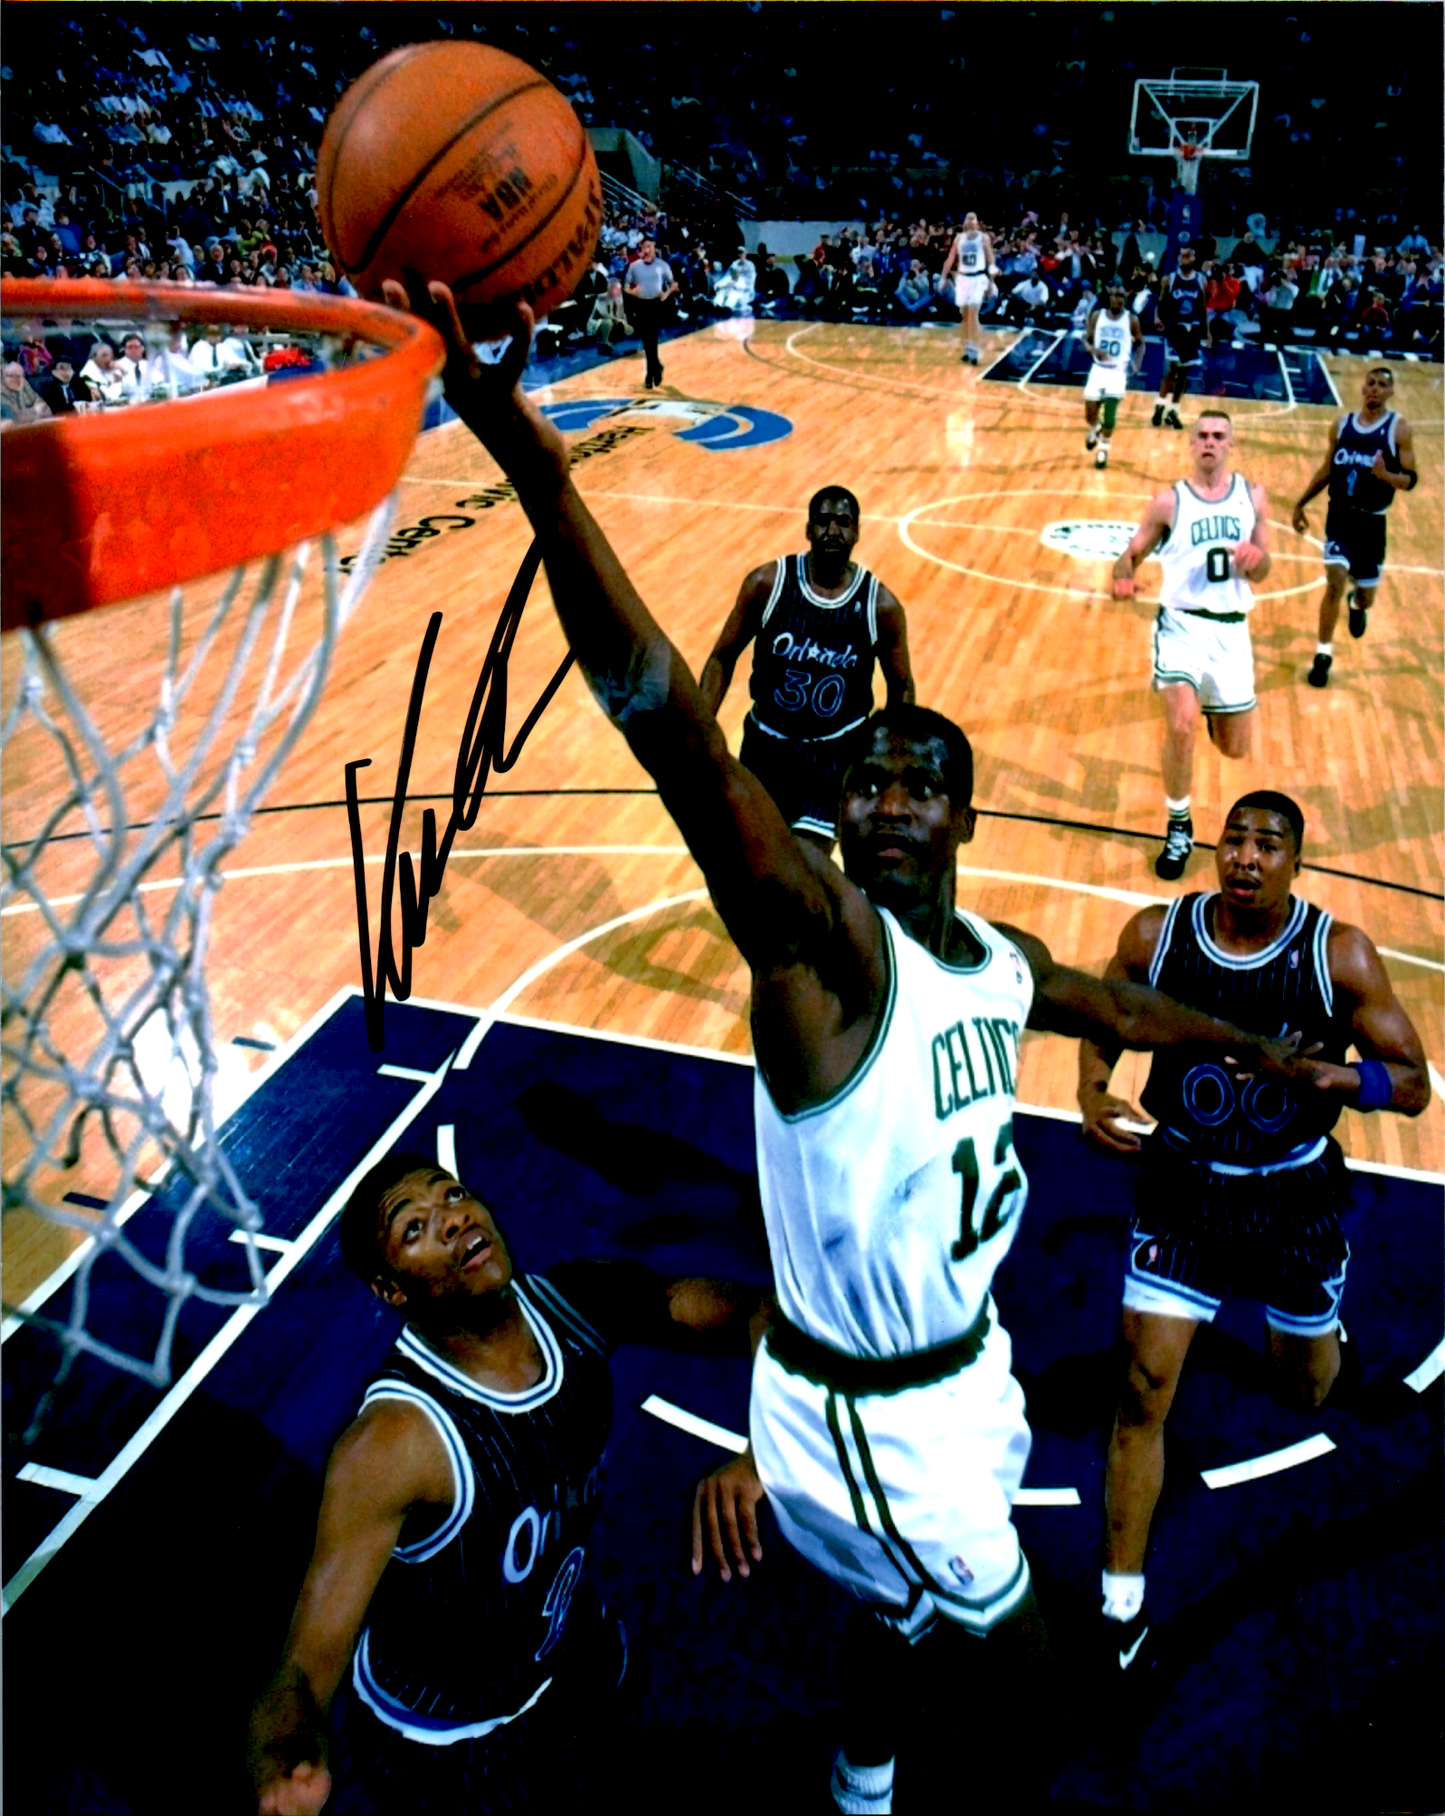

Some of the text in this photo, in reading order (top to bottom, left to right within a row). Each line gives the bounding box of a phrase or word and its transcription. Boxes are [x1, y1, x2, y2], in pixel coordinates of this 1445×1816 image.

[480, 166, 533, 220] NBA
[1191, 515, 1241, 546] CELTICS
[1206, 546, 1230, 583] 0
[773, 632, 858, 669] Orlando
[774, 669, 846, 717] 30
[931, 1017, 1019, 1121] CELTIC
[1182, 1062, 1298, 1133] 00
[951, 1119, 1022, 1263] 12
